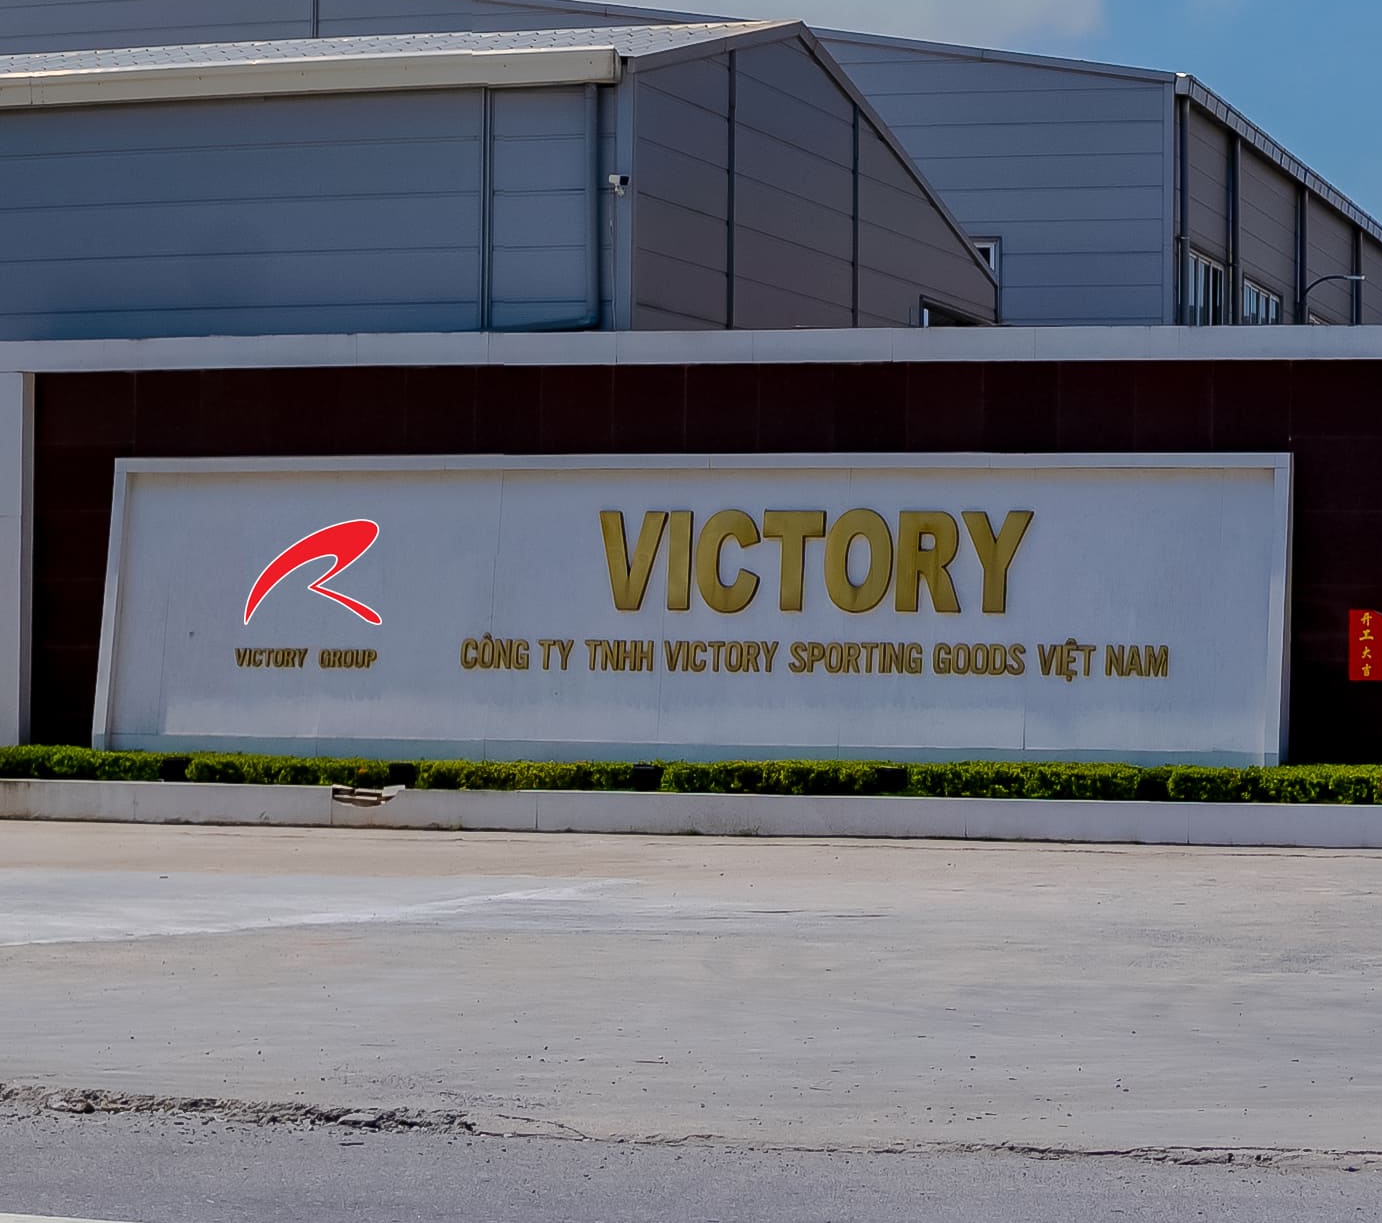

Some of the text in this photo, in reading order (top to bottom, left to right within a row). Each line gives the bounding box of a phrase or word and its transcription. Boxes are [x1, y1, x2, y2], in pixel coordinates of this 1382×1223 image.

[599, 508, 1035, 614] VICTORY
[234, 648, 378, 669] VICTORY GROUP
[460, 633, 1169, 681] CÔNG TY TNHH VICTORY SPORTING GOODS VIỆT NAM
